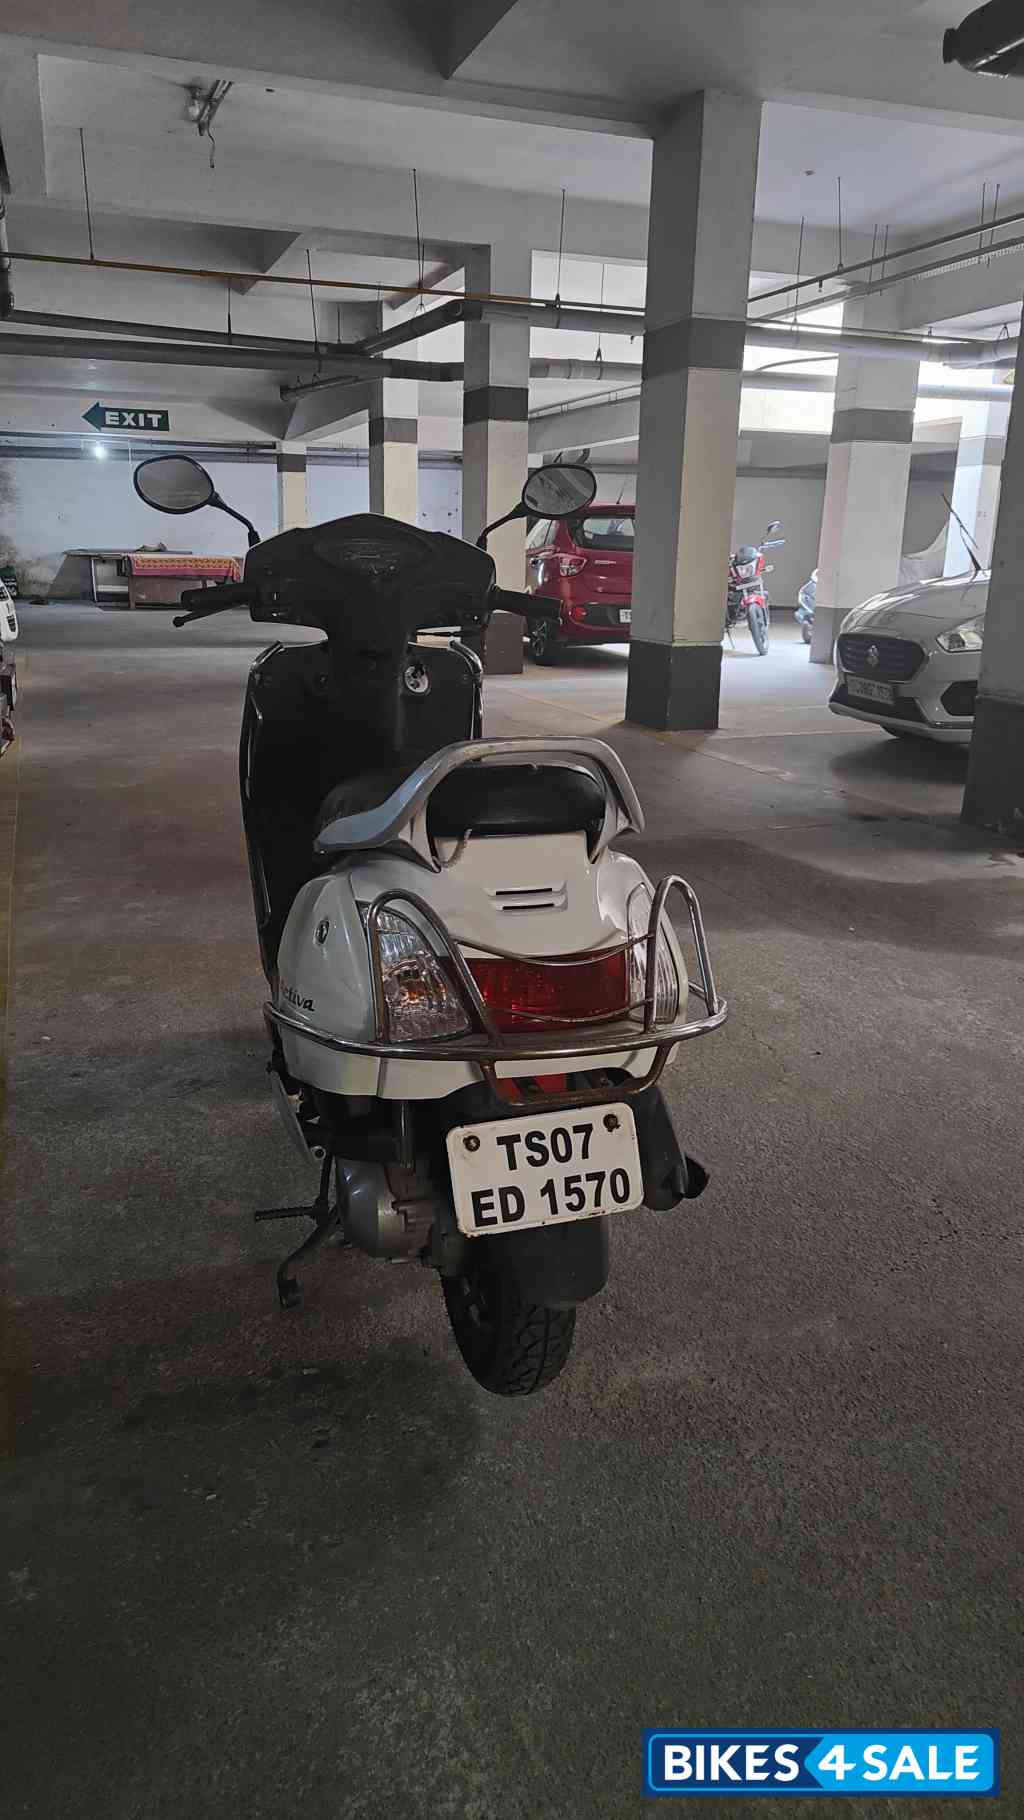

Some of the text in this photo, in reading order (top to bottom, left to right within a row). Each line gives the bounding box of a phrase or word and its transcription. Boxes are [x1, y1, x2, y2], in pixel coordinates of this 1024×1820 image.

[105, 411, 162, 428] EXIT
[496, 1123, 594, 1171] TS07
[471, 1168, 631, 1228] ED 1570
